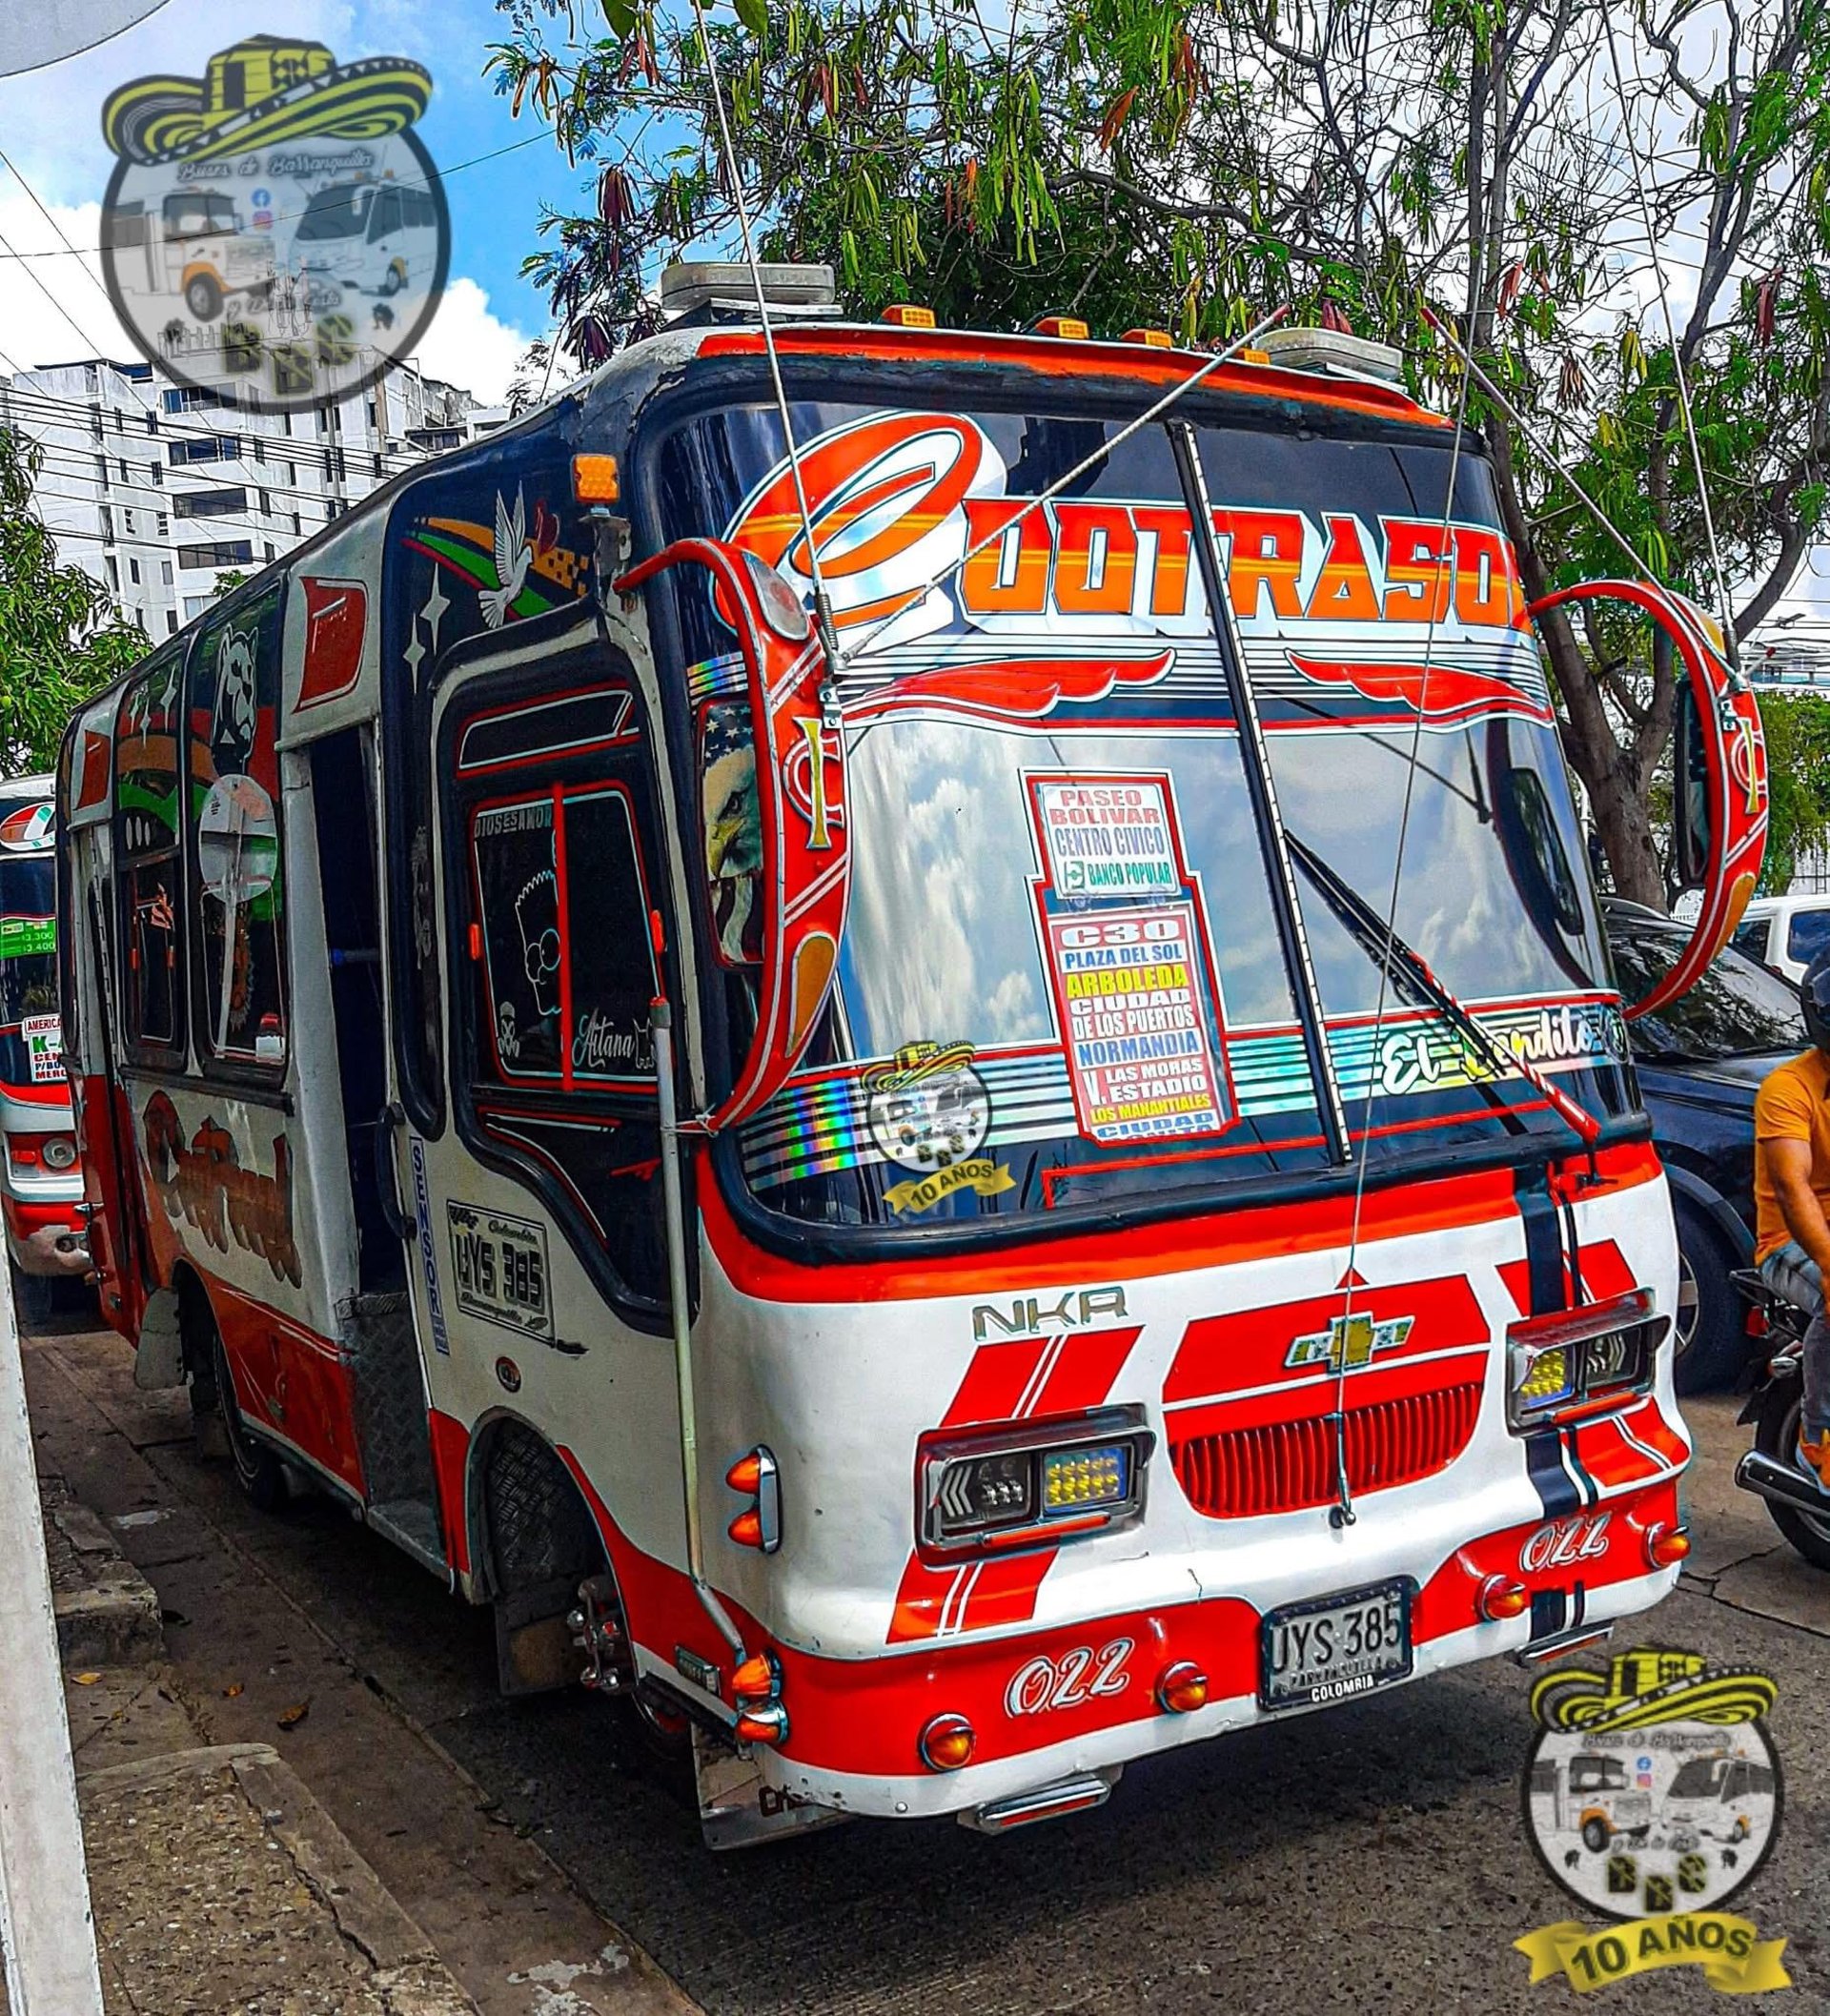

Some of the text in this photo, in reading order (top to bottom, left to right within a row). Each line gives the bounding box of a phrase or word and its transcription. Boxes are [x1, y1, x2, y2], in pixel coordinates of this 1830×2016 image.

[1060, 790, 1142, 806] PASEO
[1049, 808, 1160, 825] BOLIVAR
[1055, 826, 1165, 856] CENTRO CIVICO
[1087, 862, 1172, 886] BANCO POPULAR
[1061, 920, 1180, 947] C30
[1065, 944, 1182, 969] PLAZA DEL SOL
[1067, 964, 1189, 999] ARBOLEDA
[1069, 988, 1190, 1016] CIUDAD
[1071, 1005, 1195, 1040] DE LOS PUERTOS
[1078, 1030, 1199, 1067] NORMANDIA
[1382, 1031, 1440, 1095] El
[1104, 1067, 1138, 1084] LAS
[1141, 1058, 1204, 1079] MORAS
[1109, 1074, 1208, 1103] ESTADIO
[1090, 1093, 1211, 1124] LOS MANANTIALES
[1096, 1112, 1213, 1138] CIUDAD
[972, 1286, 1128, 1340] NKR
[1342, 1601, 1401, 1660] 385
